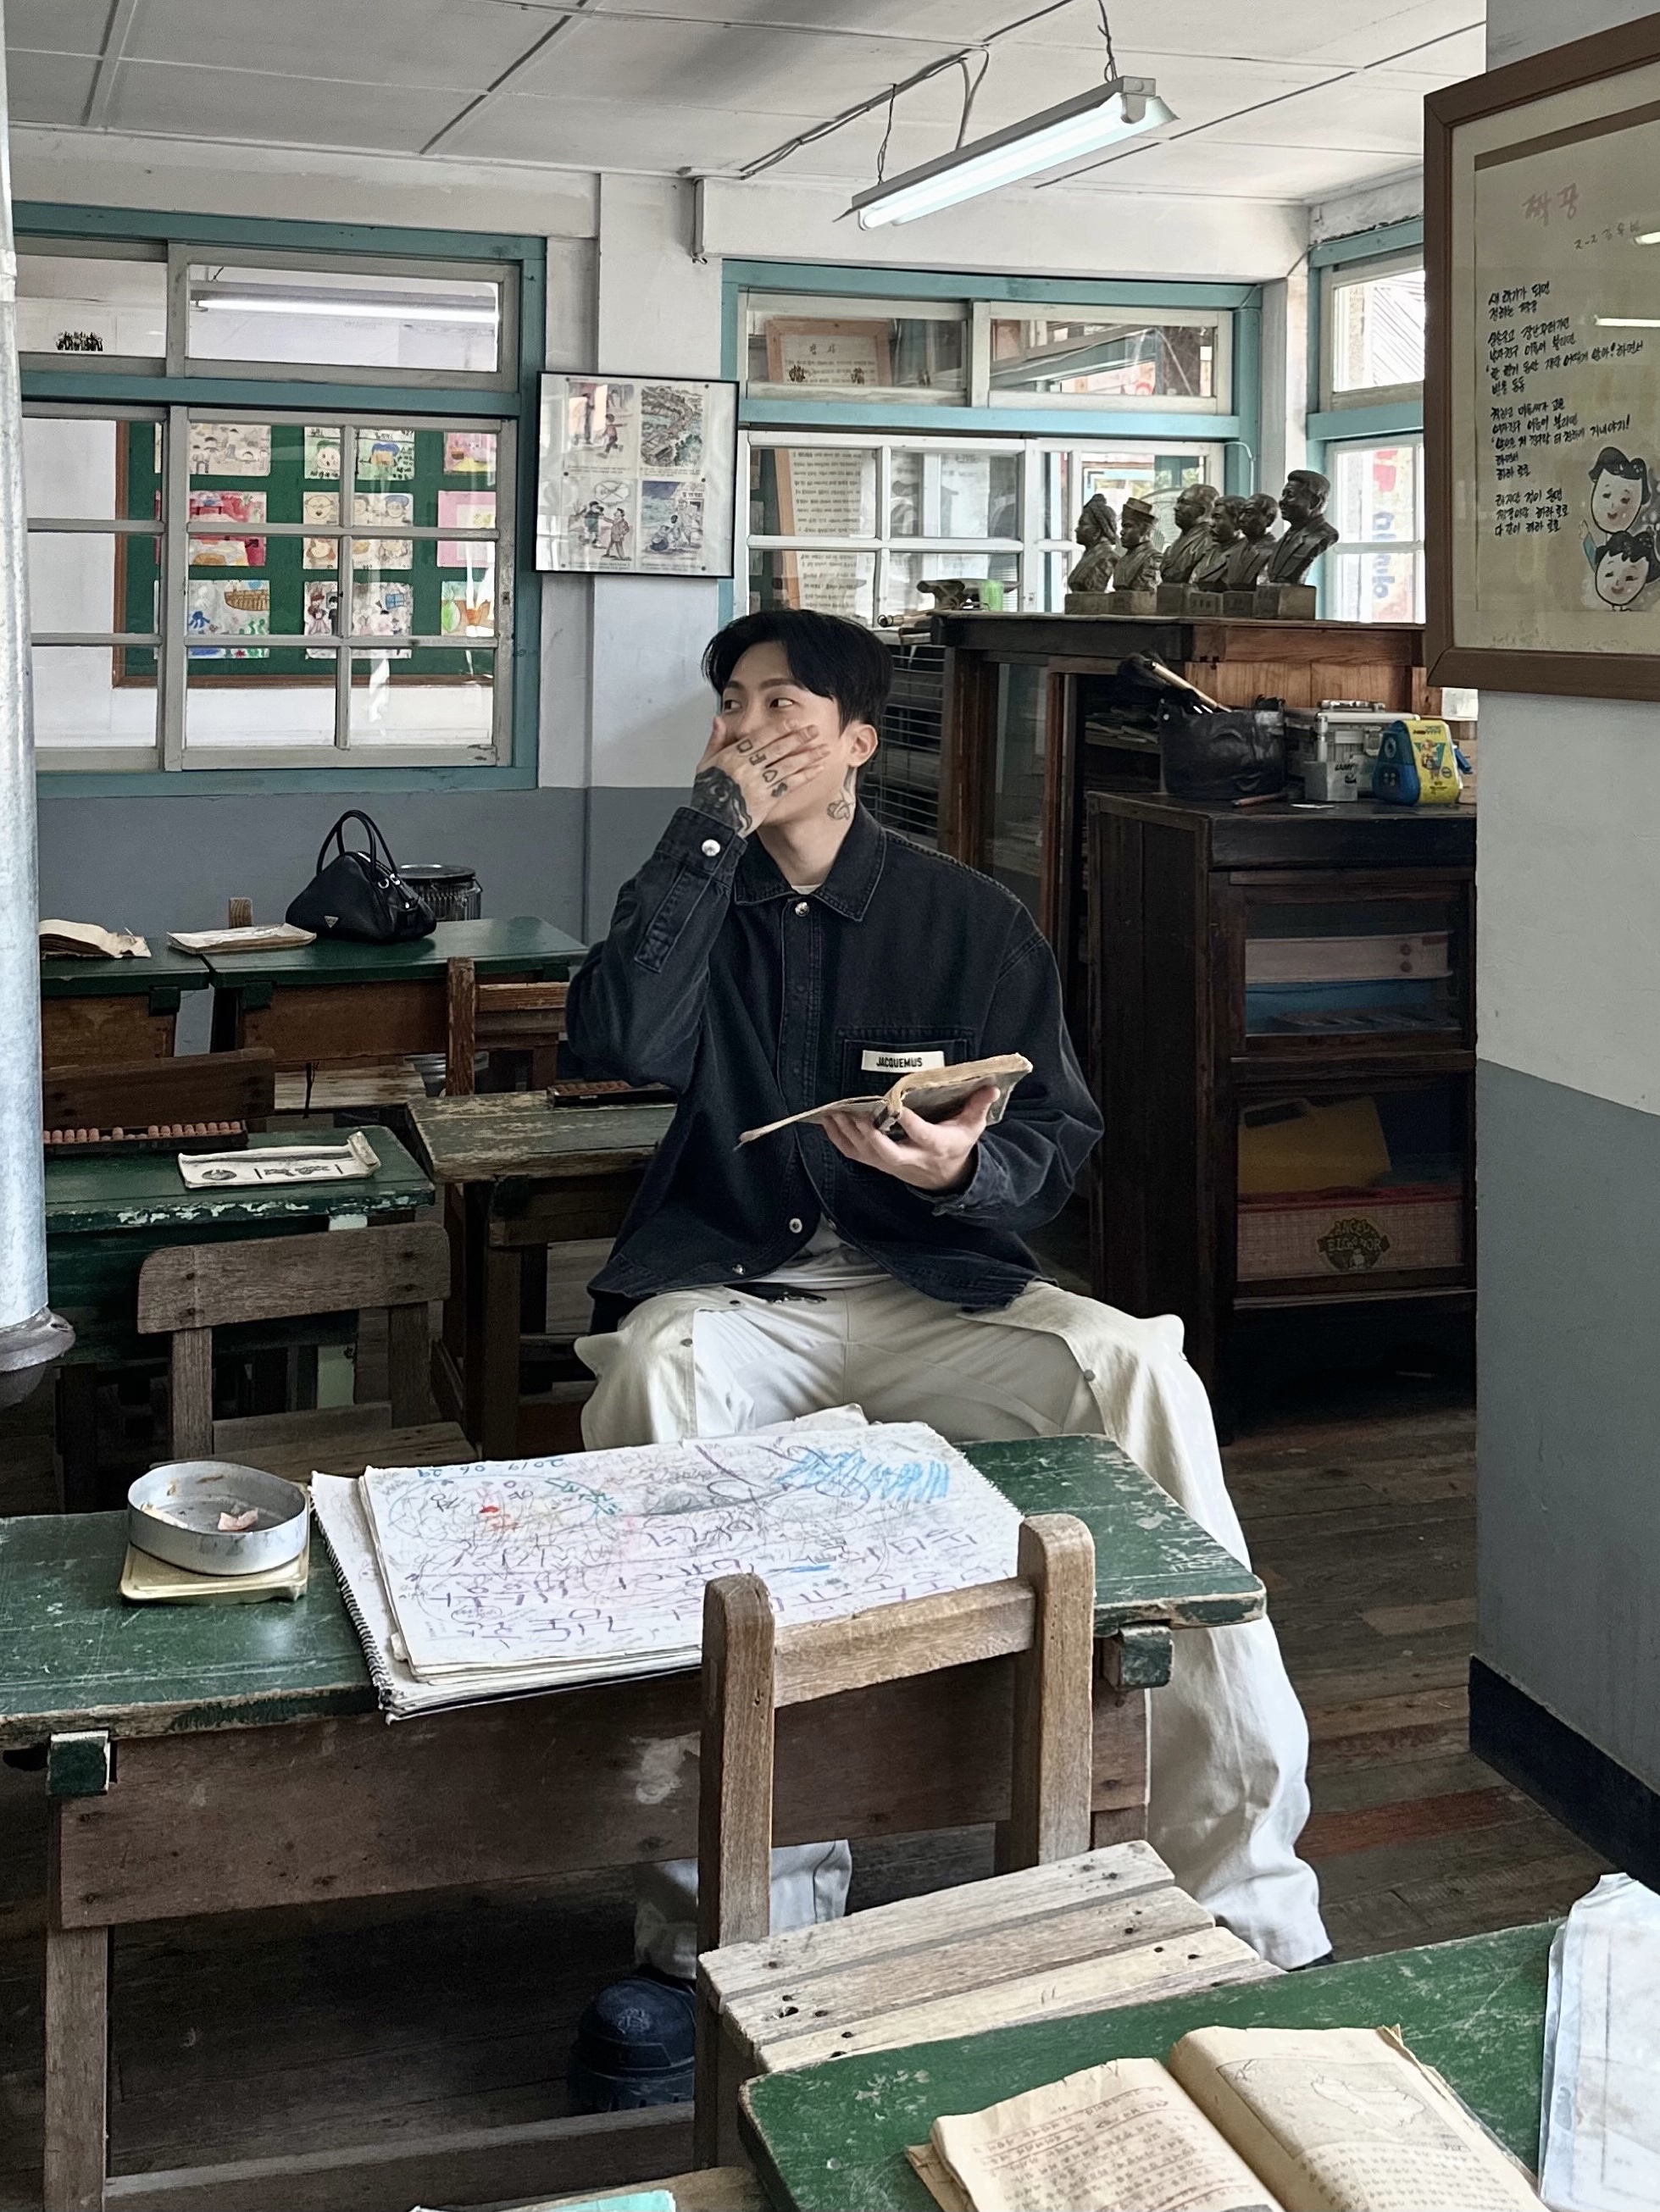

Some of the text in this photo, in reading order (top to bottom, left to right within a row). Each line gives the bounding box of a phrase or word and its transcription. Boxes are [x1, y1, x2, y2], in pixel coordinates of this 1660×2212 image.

[1531, 280, 1551, 297] 되면
[1489, 305, 1514, 322] 정하는
[1523, 359, 1540, 374] 동안
[875, 1056, 923, 1067] JACQUEMUS
